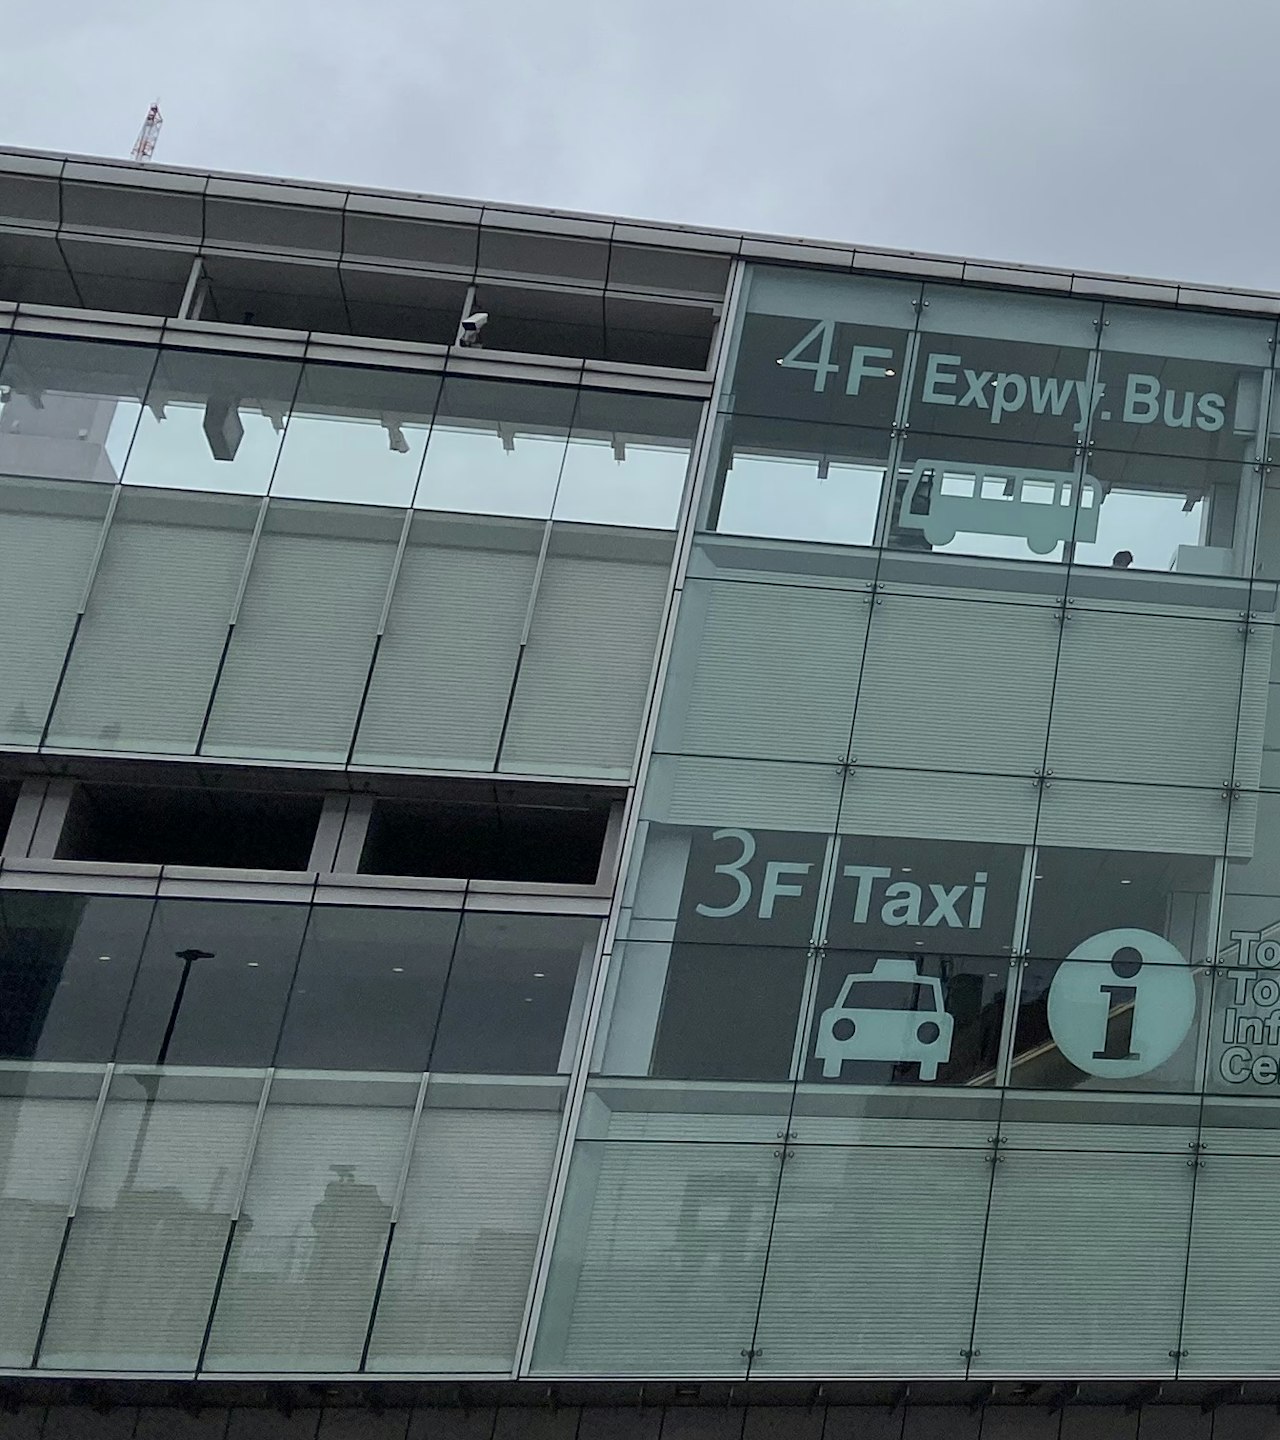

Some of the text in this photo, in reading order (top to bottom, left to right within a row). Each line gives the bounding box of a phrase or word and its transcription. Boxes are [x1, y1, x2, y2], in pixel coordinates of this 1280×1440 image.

[777, 320, 1227, 433] 4F Expwy. Bus
[696, 828, 988, 929] 3F Taxi
